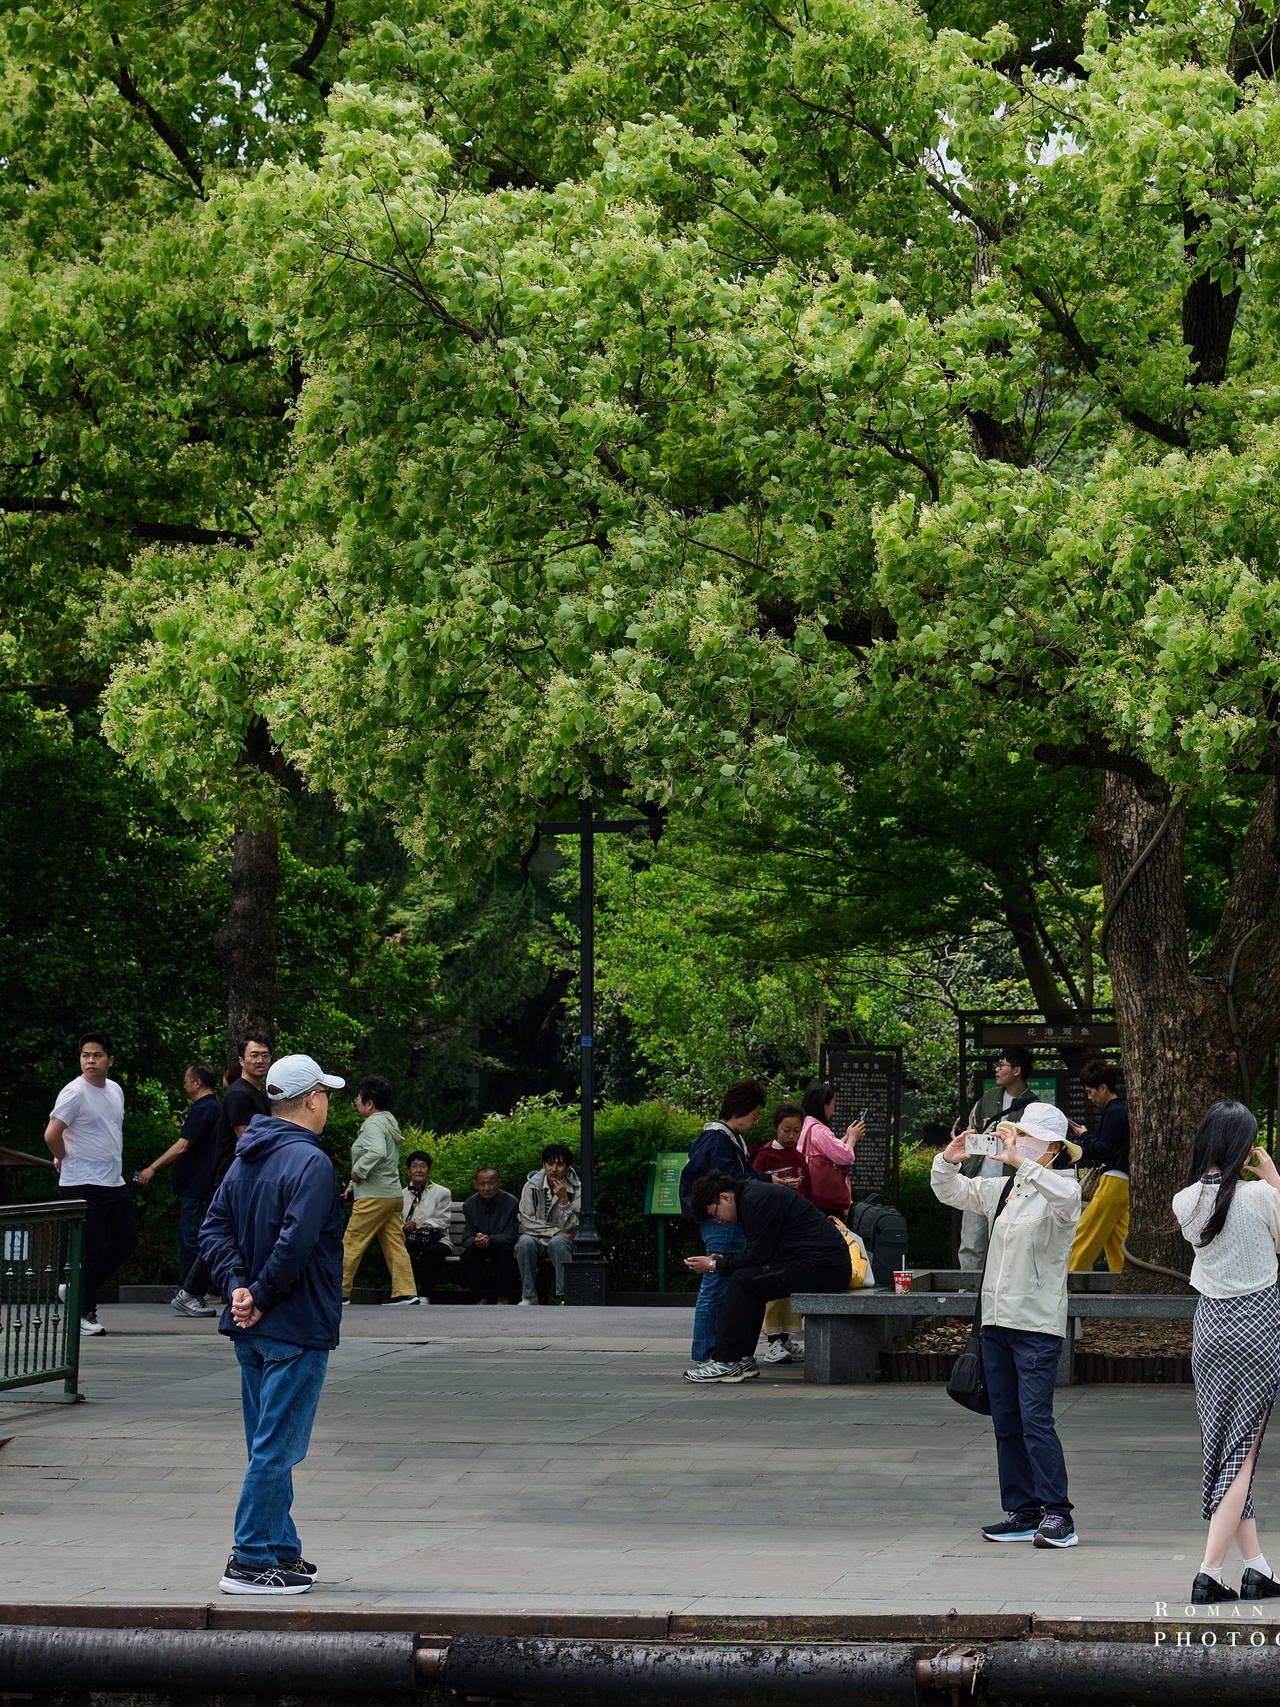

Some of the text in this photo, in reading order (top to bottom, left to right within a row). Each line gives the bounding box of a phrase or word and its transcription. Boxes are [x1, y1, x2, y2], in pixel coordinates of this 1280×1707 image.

[1026, 1027, 1091, 1036] 花港观鱼
[842, 1062, 880, 1070] 花港观鱼
